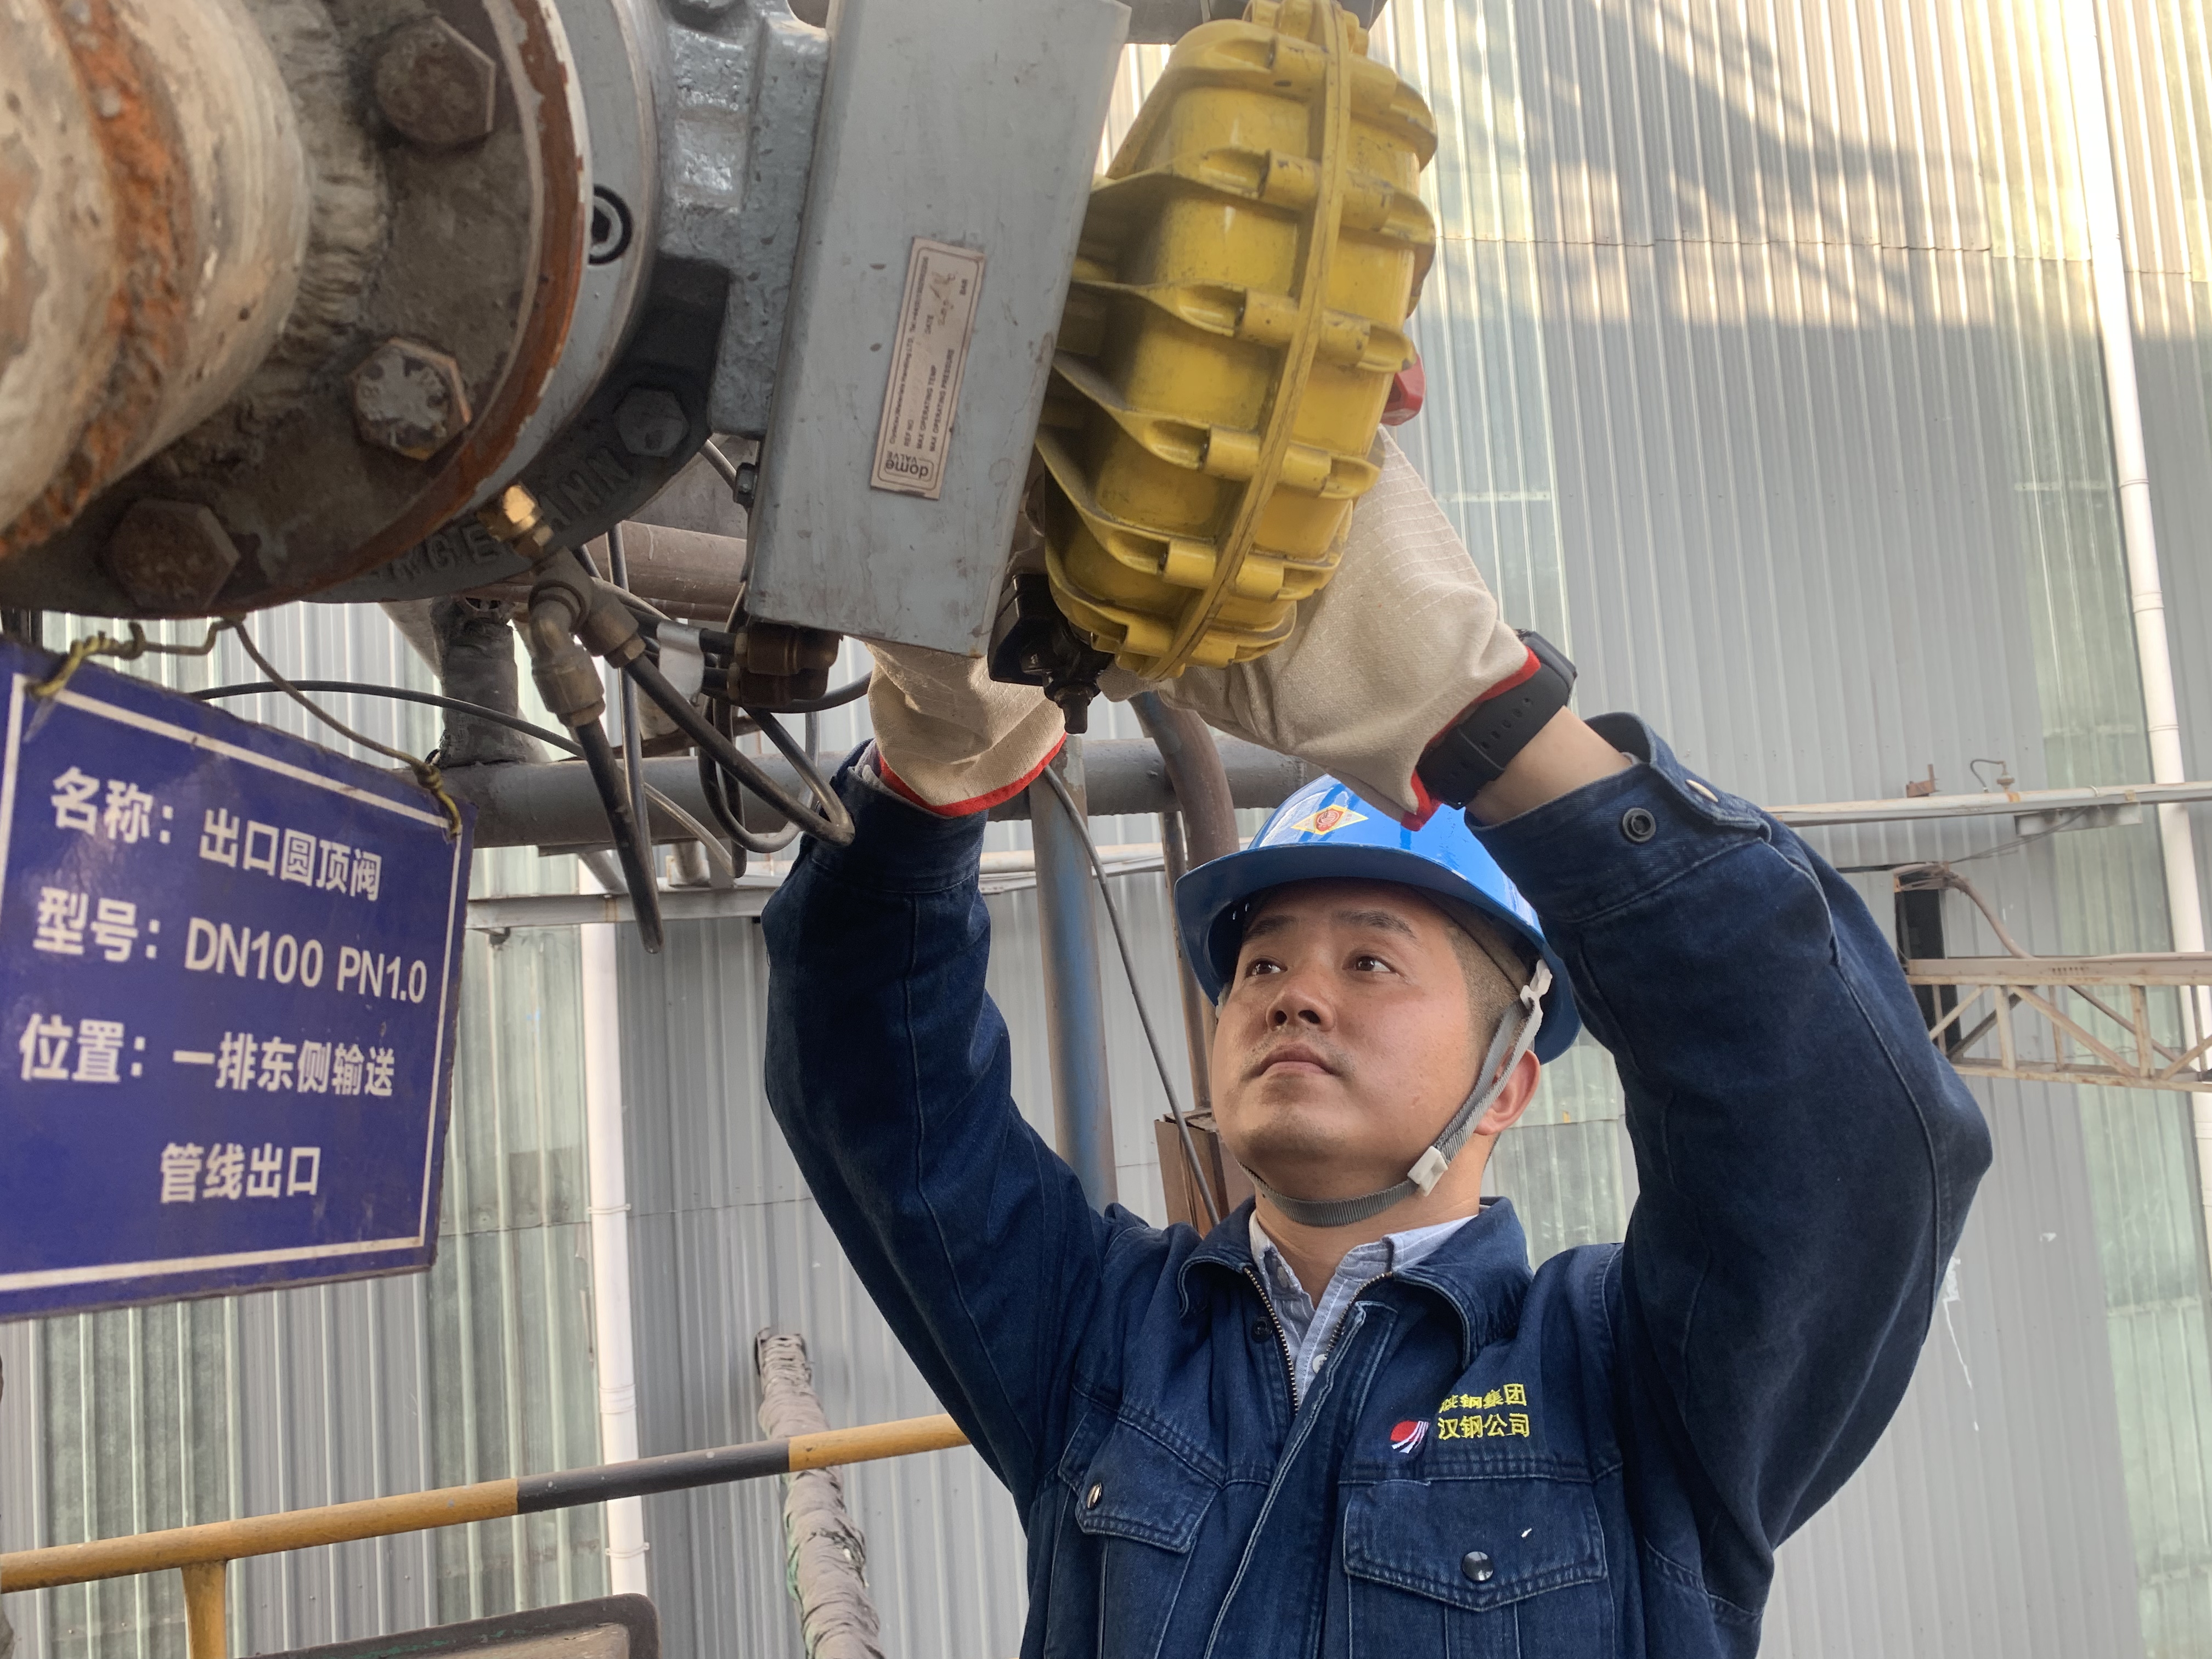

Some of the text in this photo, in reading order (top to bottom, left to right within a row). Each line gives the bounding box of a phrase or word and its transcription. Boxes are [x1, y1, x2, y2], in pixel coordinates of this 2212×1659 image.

[958, 278, 968, 296] BAR
[926, 314, 934, 335] DATE
[916, 364, 938, 449] MAX OPERATING TEMP
[929, 348, 955, 452] MAX OPERATING PRESSURE
[903, 432, 912, 447] REF
[885, 459, 929, 479] dome
[886, 450, 917, 464] VALVE
[337, 947, 426, 1002] PN1.0
[161, 1143, 320, 1203] 管线出口
[1438, 1413, 1530, 1440] 汉钢公司
